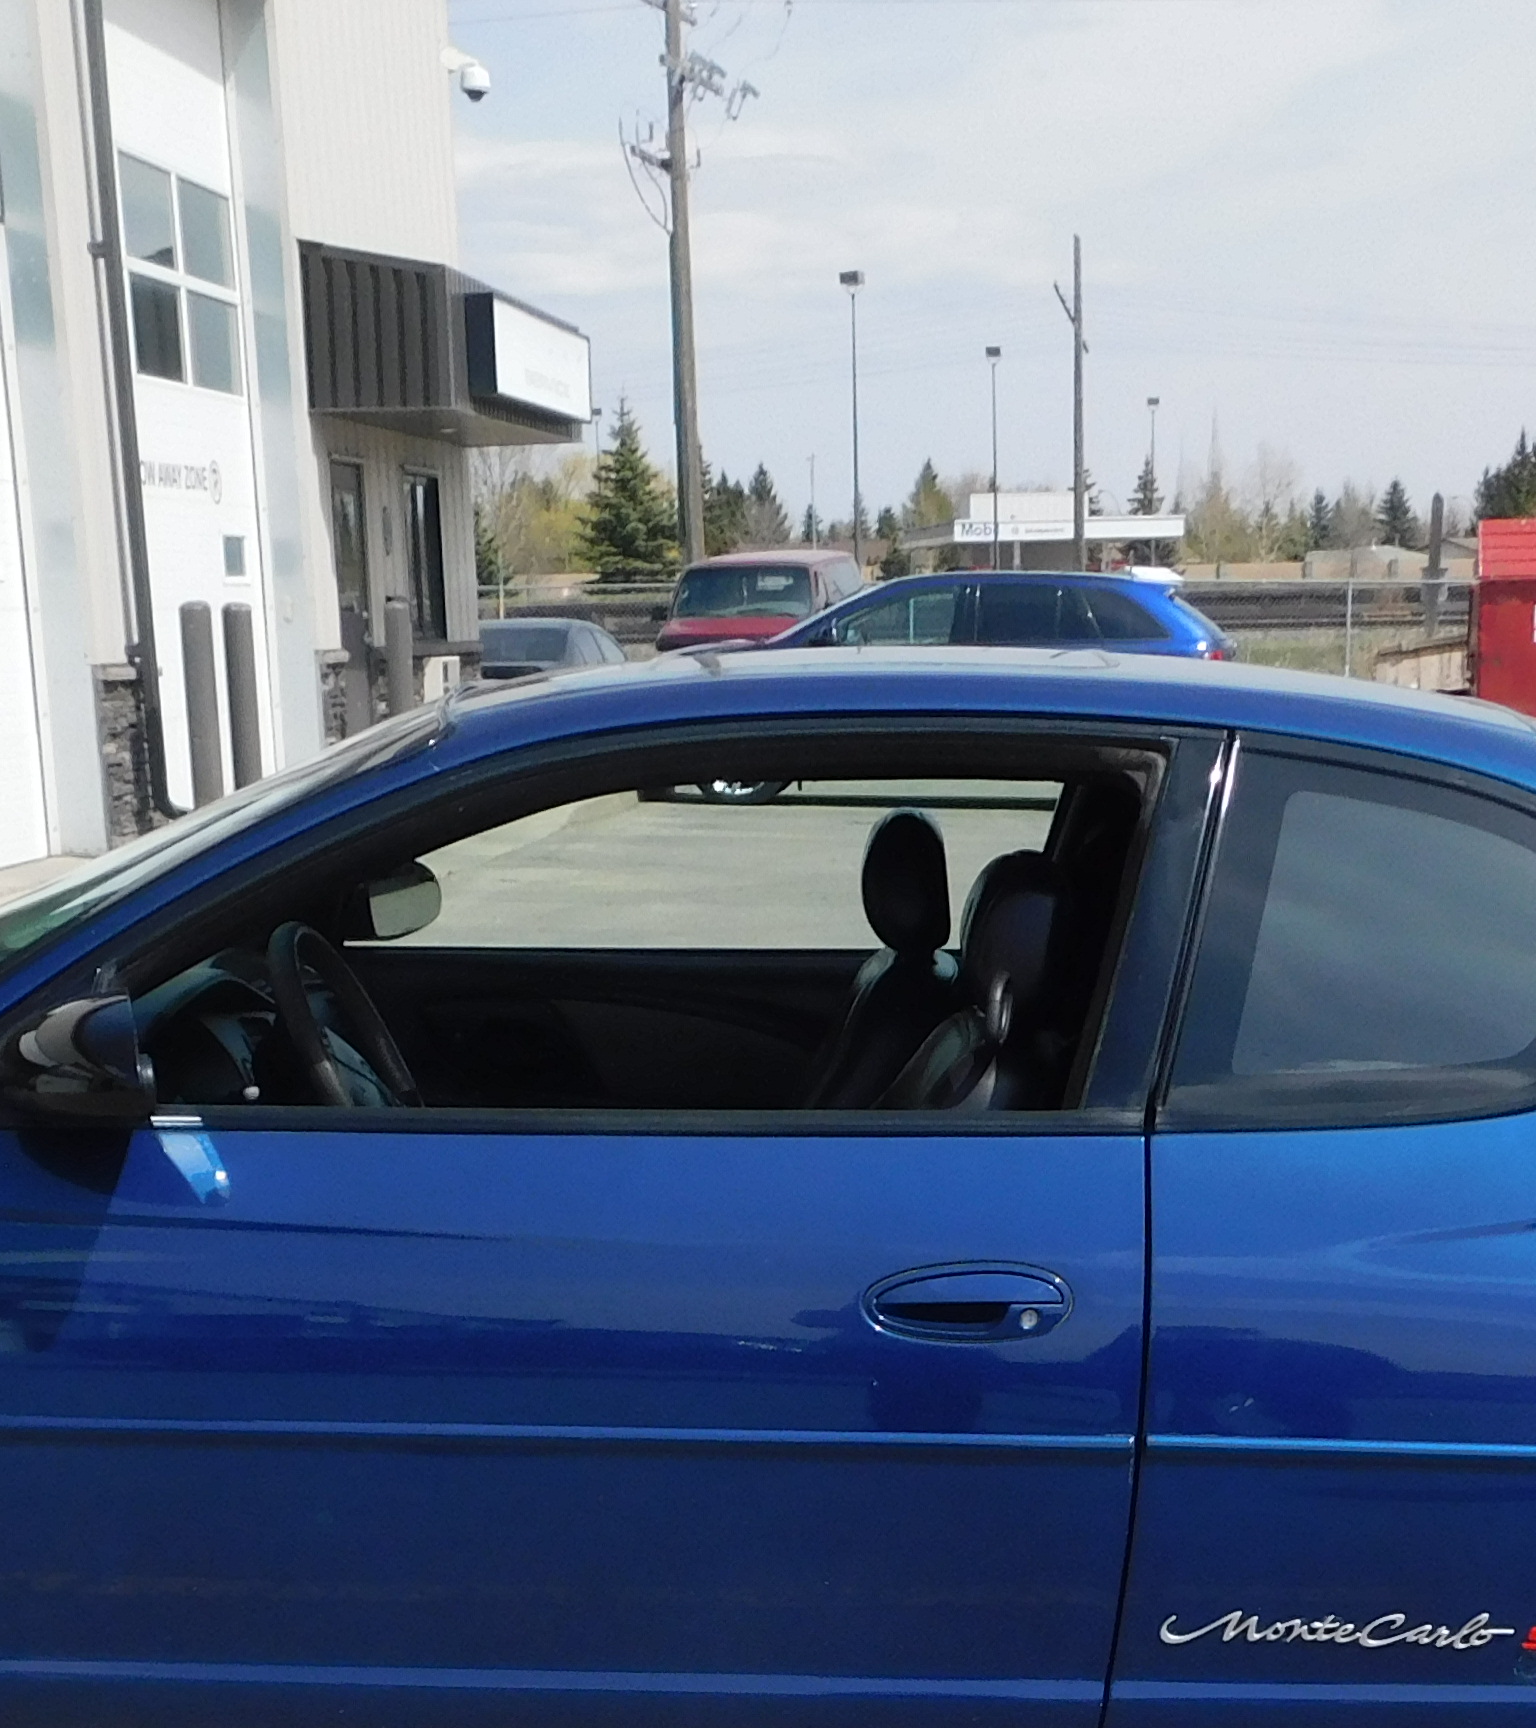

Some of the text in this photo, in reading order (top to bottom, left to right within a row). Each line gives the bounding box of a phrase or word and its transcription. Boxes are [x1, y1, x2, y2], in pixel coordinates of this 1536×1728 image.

[158, 463, 182, 489] AWAY
[184, 465, 209, 492] ZONE
[961, 522, 998, 537] Mob
